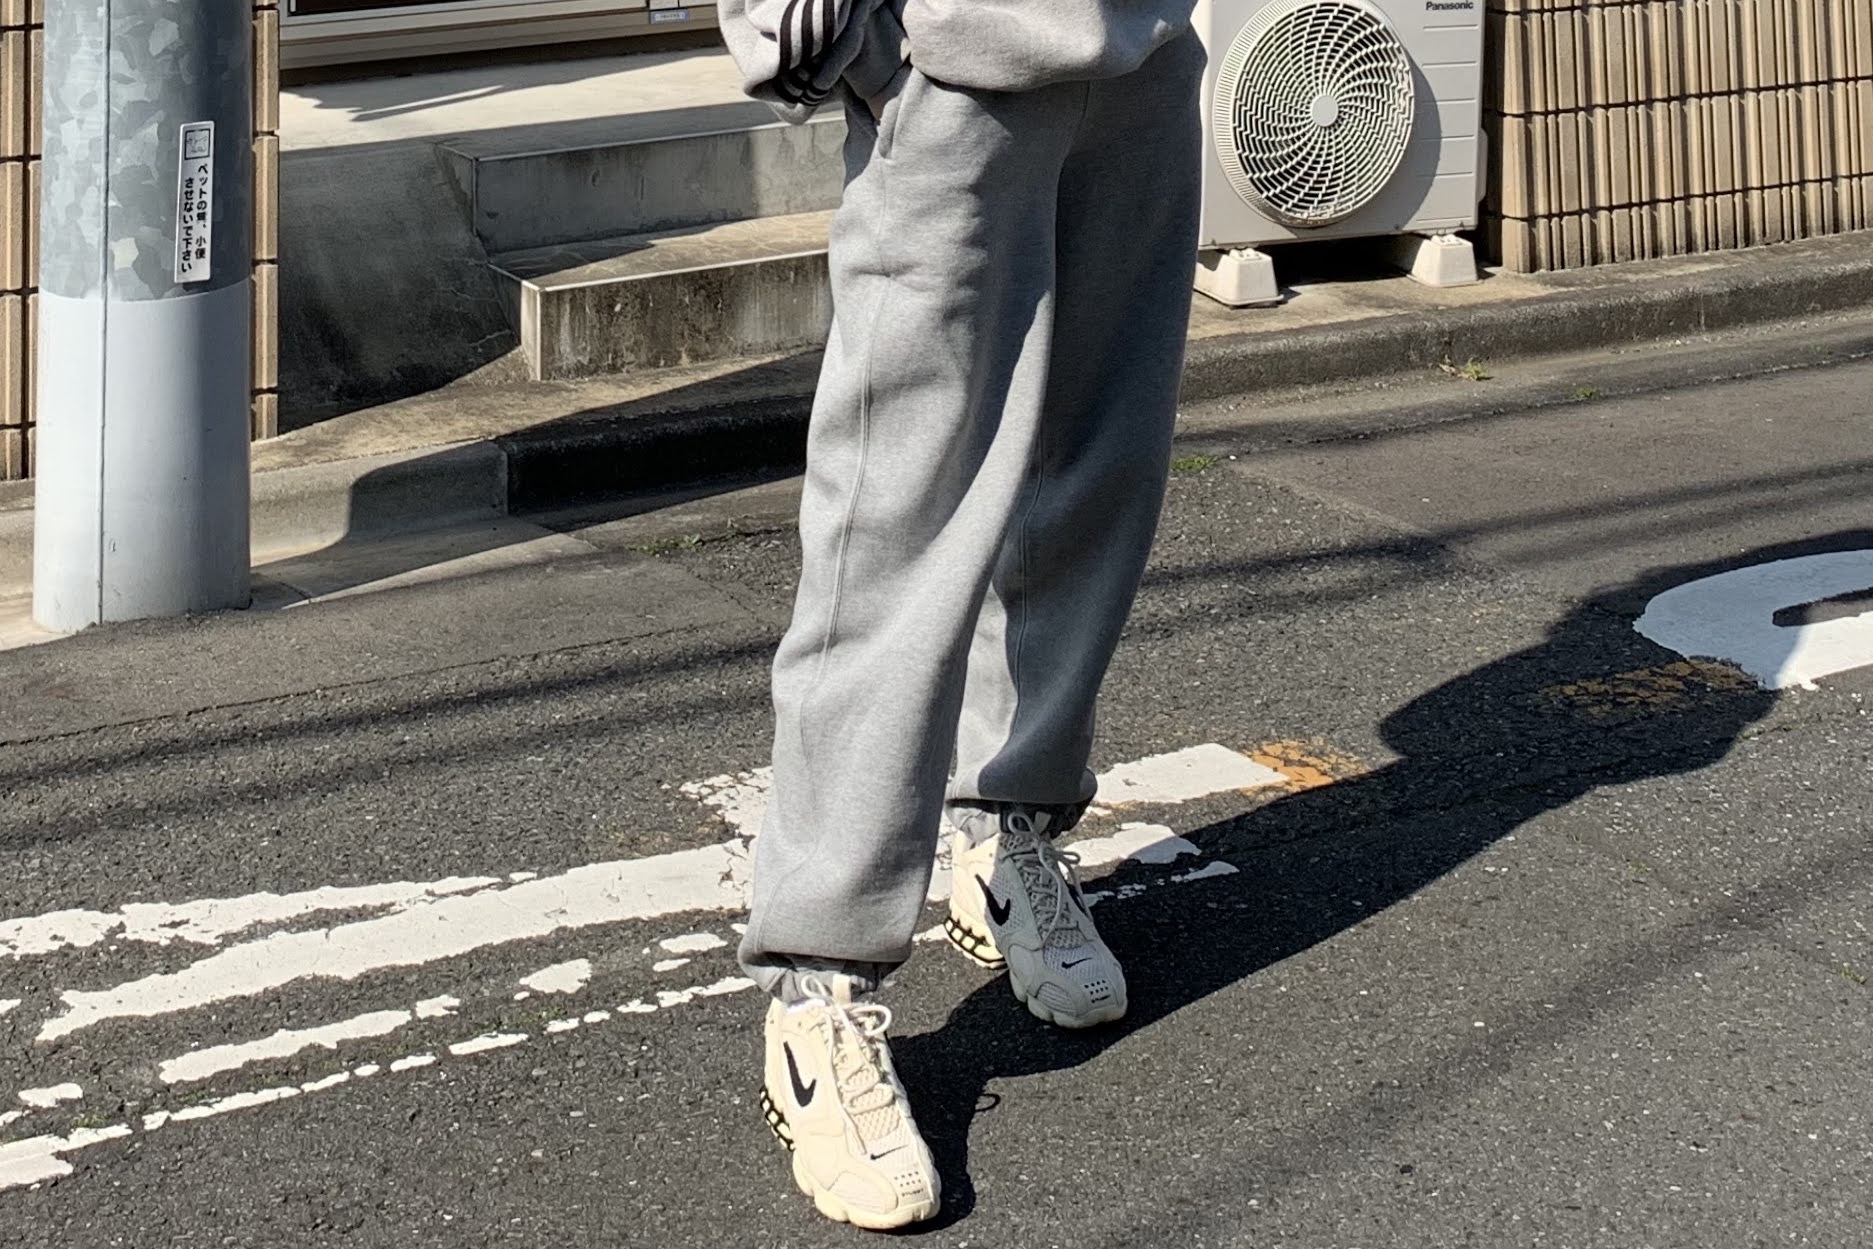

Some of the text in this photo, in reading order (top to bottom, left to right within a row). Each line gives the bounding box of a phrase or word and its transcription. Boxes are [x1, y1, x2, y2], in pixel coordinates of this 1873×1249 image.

[1426, 0, 1474, 11] Panasonic
[181, 177, 195, 273] させないで下さい
